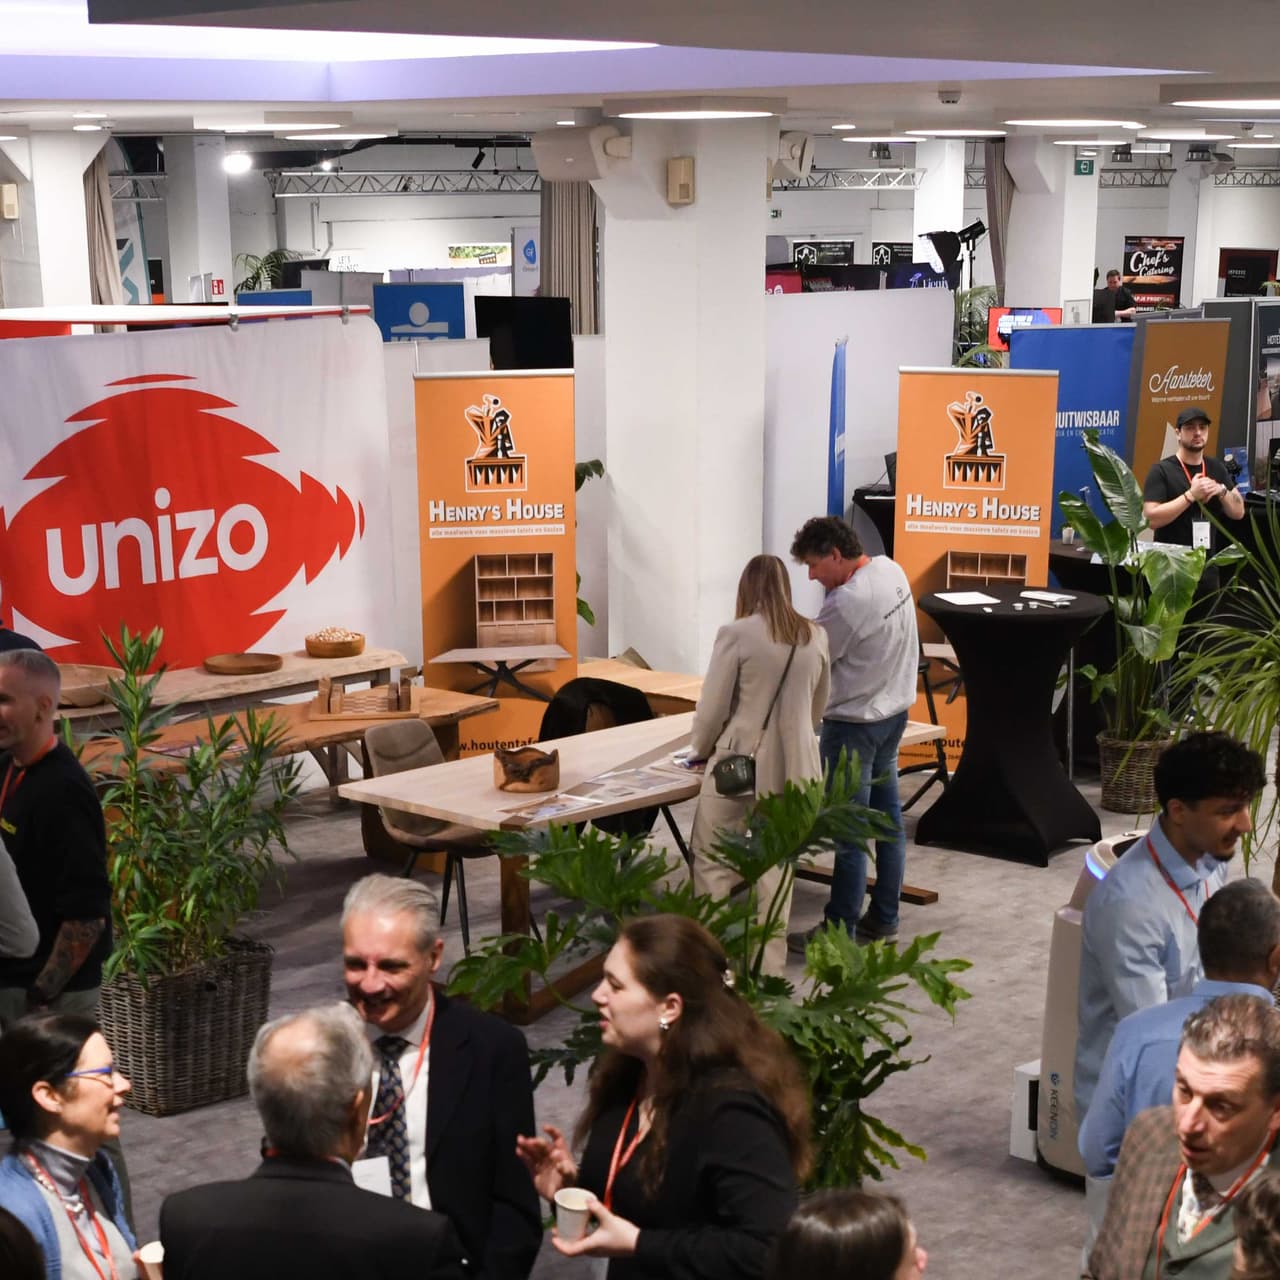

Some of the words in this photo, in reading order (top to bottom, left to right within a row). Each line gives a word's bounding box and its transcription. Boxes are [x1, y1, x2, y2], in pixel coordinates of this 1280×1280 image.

[1130, 249, 1169, 273] Chef's
[1149, 364, 1215, 394] Aansteker
[429, 500, 503, 522] HENRY'S
[506, 498, 565, 521] HOUSE
[906, 494, 978, 519] HENRY'S
[982, 496, 1041, 521] HOUSE
[46, 487, 270, 597] unizo
